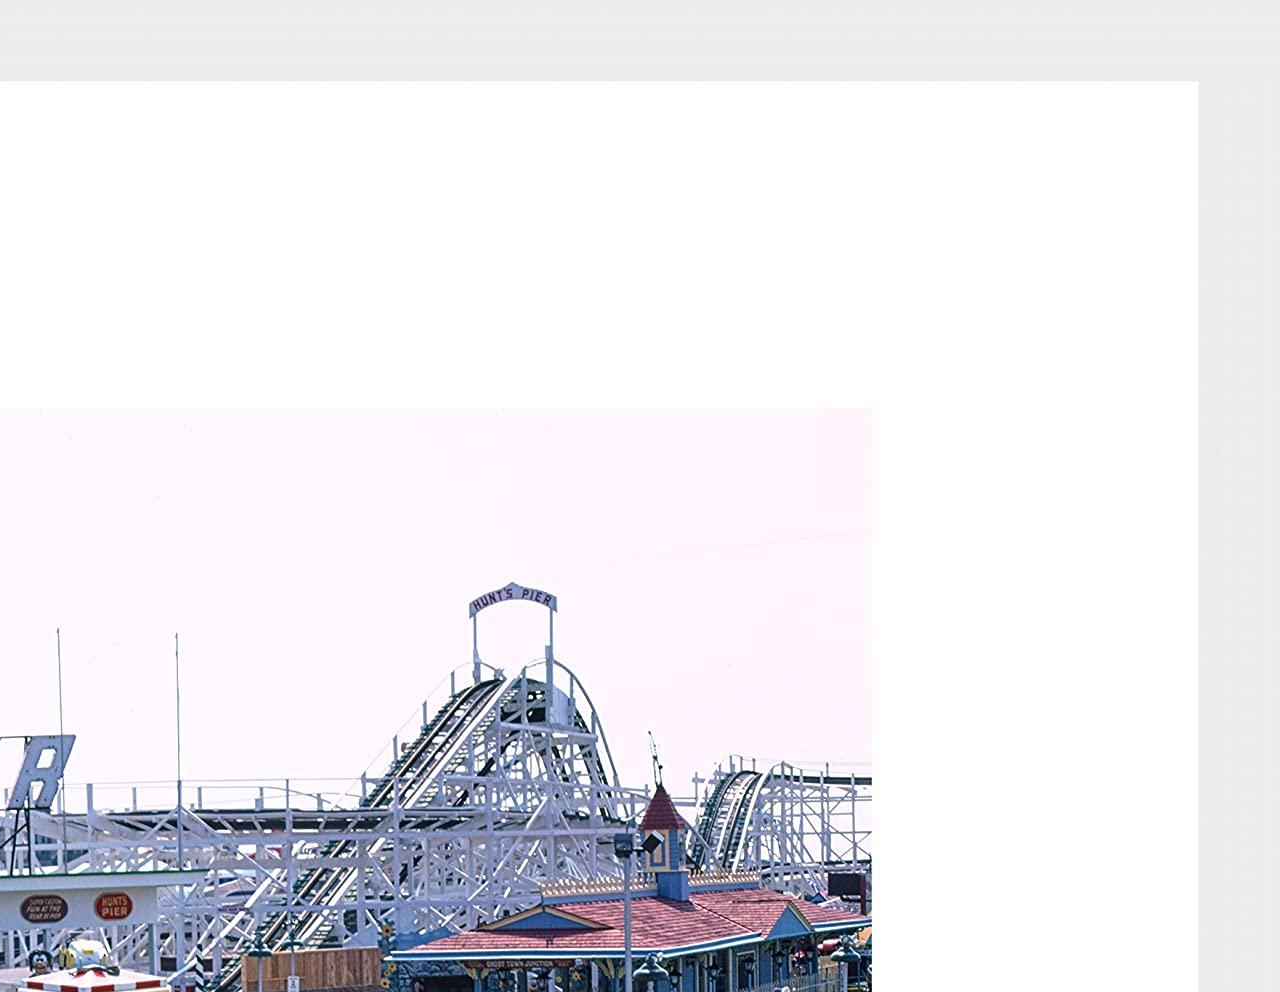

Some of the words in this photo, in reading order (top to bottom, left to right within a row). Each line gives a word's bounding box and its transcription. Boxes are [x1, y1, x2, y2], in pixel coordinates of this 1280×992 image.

[472, 588, 513, 610] HUNT'S
[522, 589, 552, 606] PIER
[102, 907, 128, 917] PIER
[506, 960, 524, 968] TOWN
[524, 960, 553, 968] JUNCTION
